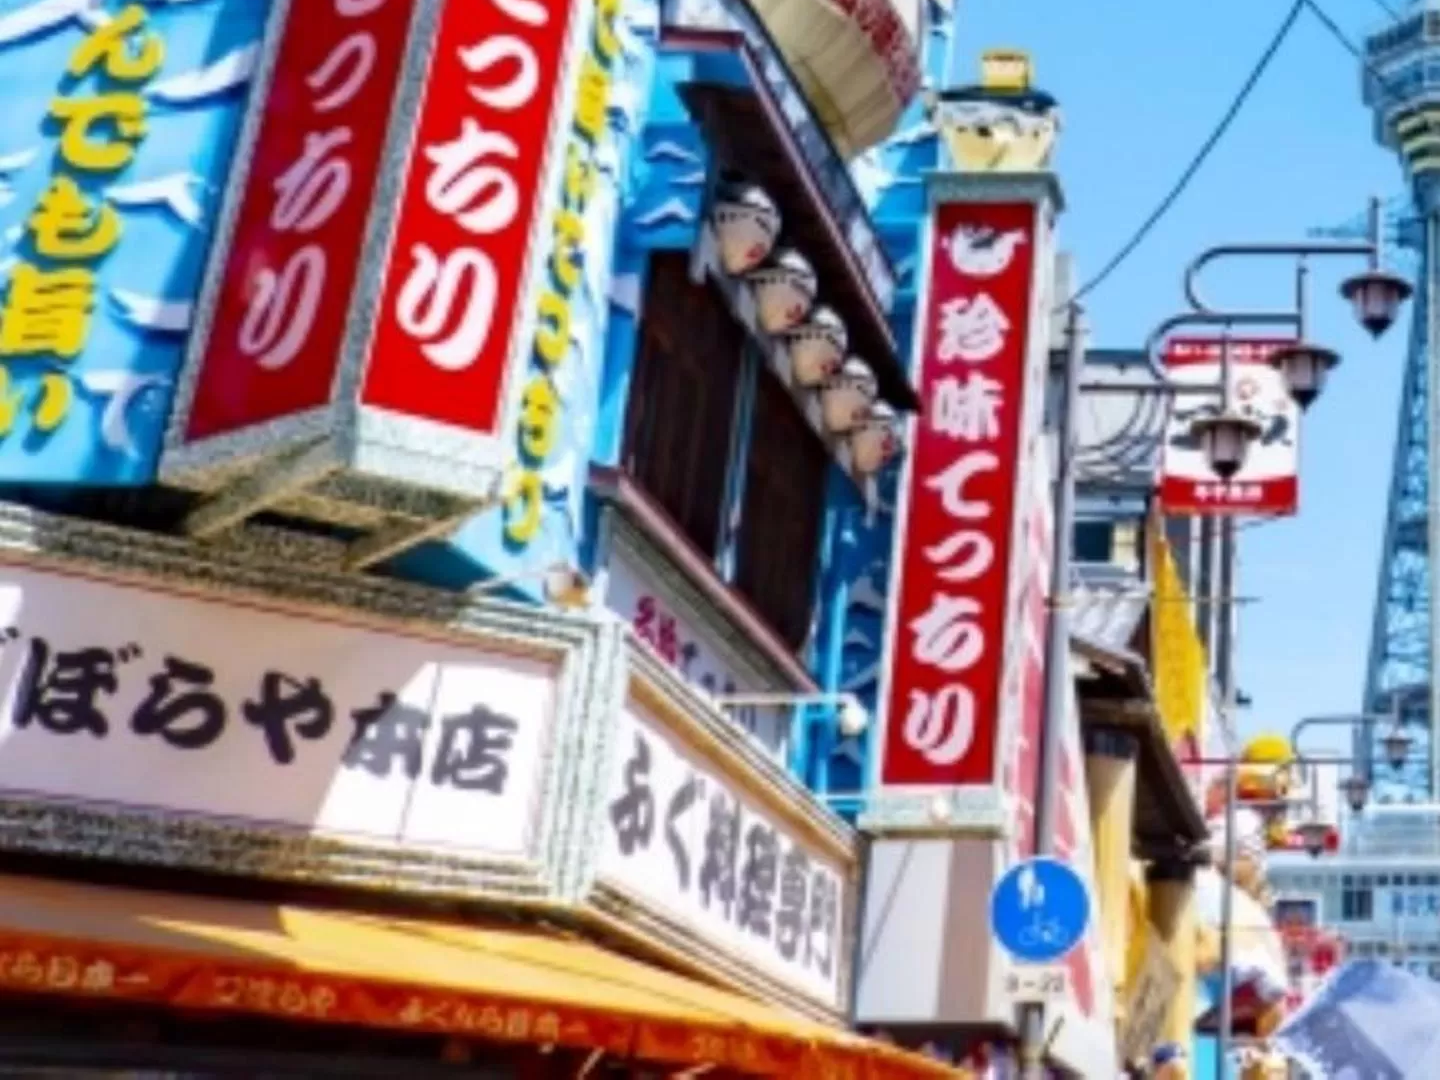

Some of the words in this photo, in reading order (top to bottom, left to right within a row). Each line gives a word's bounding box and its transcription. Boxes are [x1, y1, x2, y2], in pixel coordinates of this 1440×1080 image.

[903, 295, 1012, 766] 珍味てっちり
[0, 626, 518, 794] ぼらや本店
